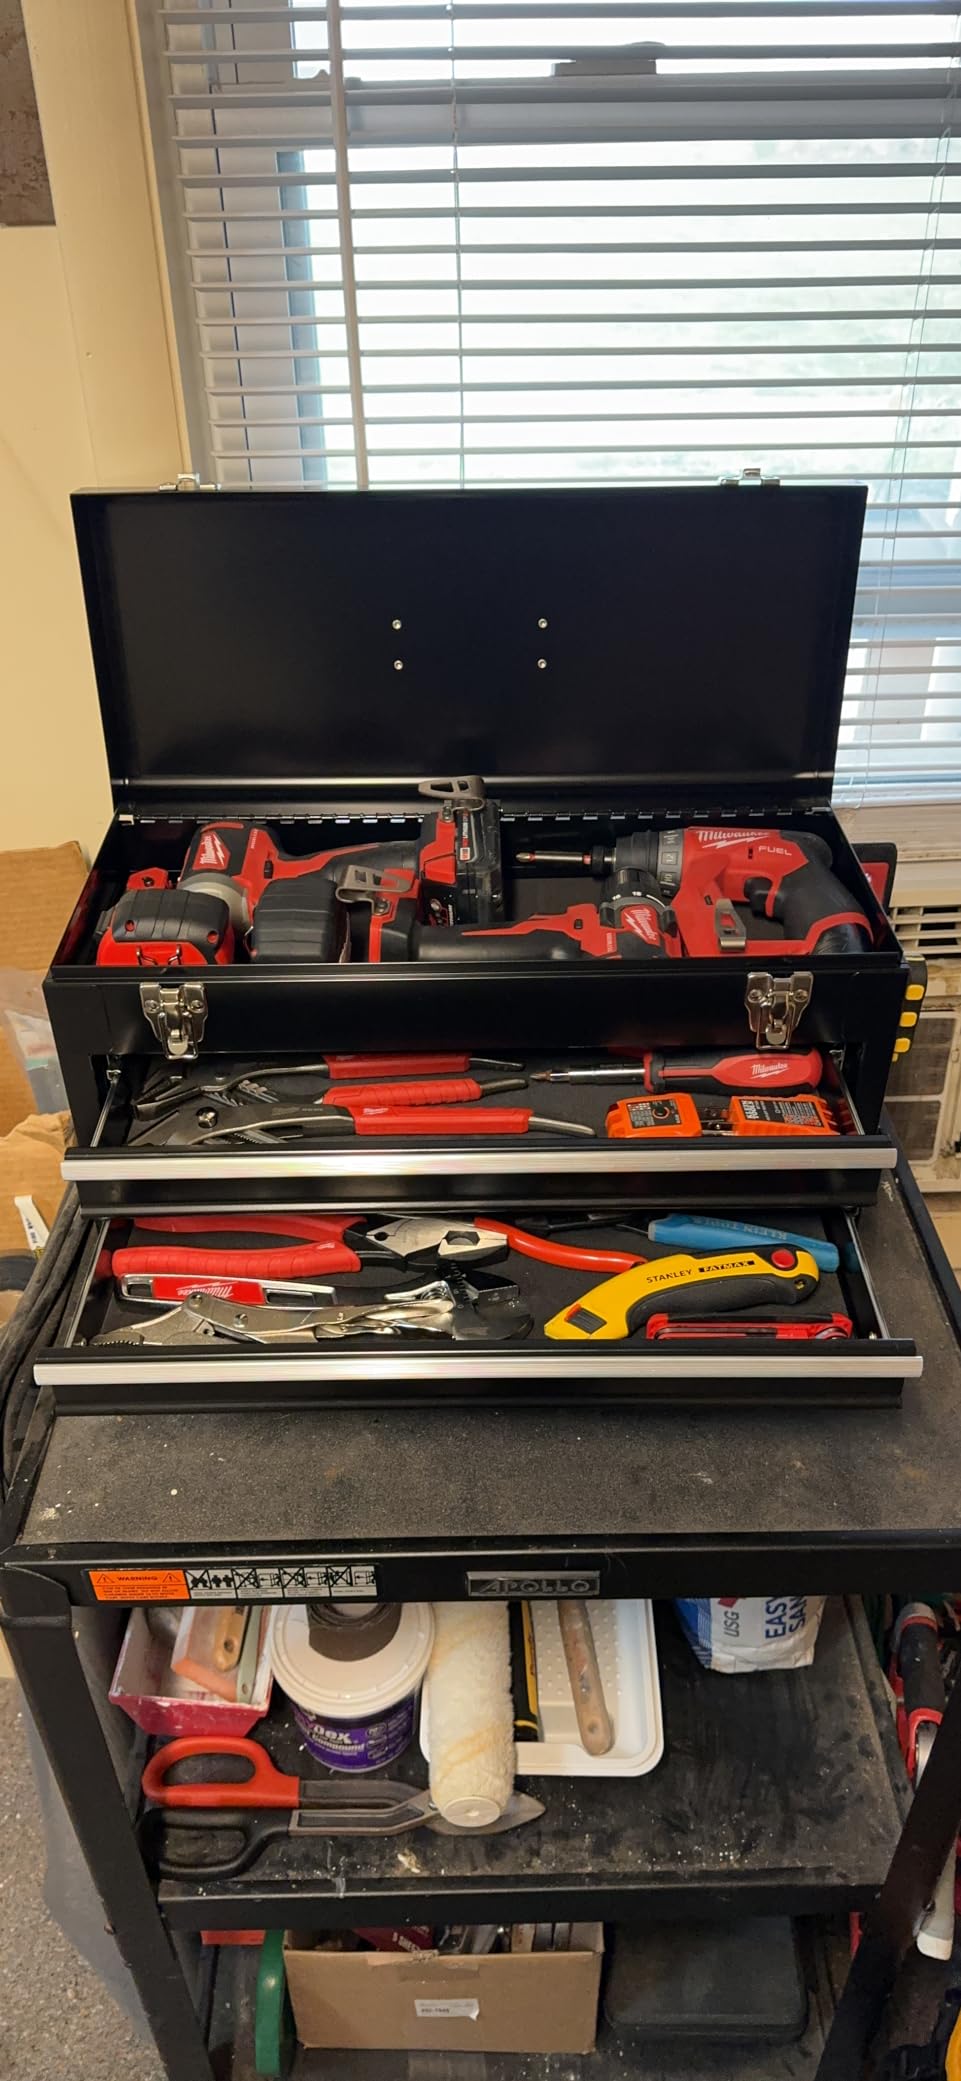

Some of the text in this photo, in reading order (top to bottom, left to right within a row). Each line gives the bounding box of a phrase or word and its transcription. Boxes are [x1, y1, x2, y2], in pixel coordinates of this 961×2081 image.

[695, 830, 769, 842] Milwaukee
[757, 845, 793, 856] FUEL
[750, 1062, 788, 1076] Milwaukee
[646, 1261, 750, 1284] STANLEY FATMAX
[481, 1580, 590, 1593] APOLLO
[724, 1610, 740, 1638] USG
